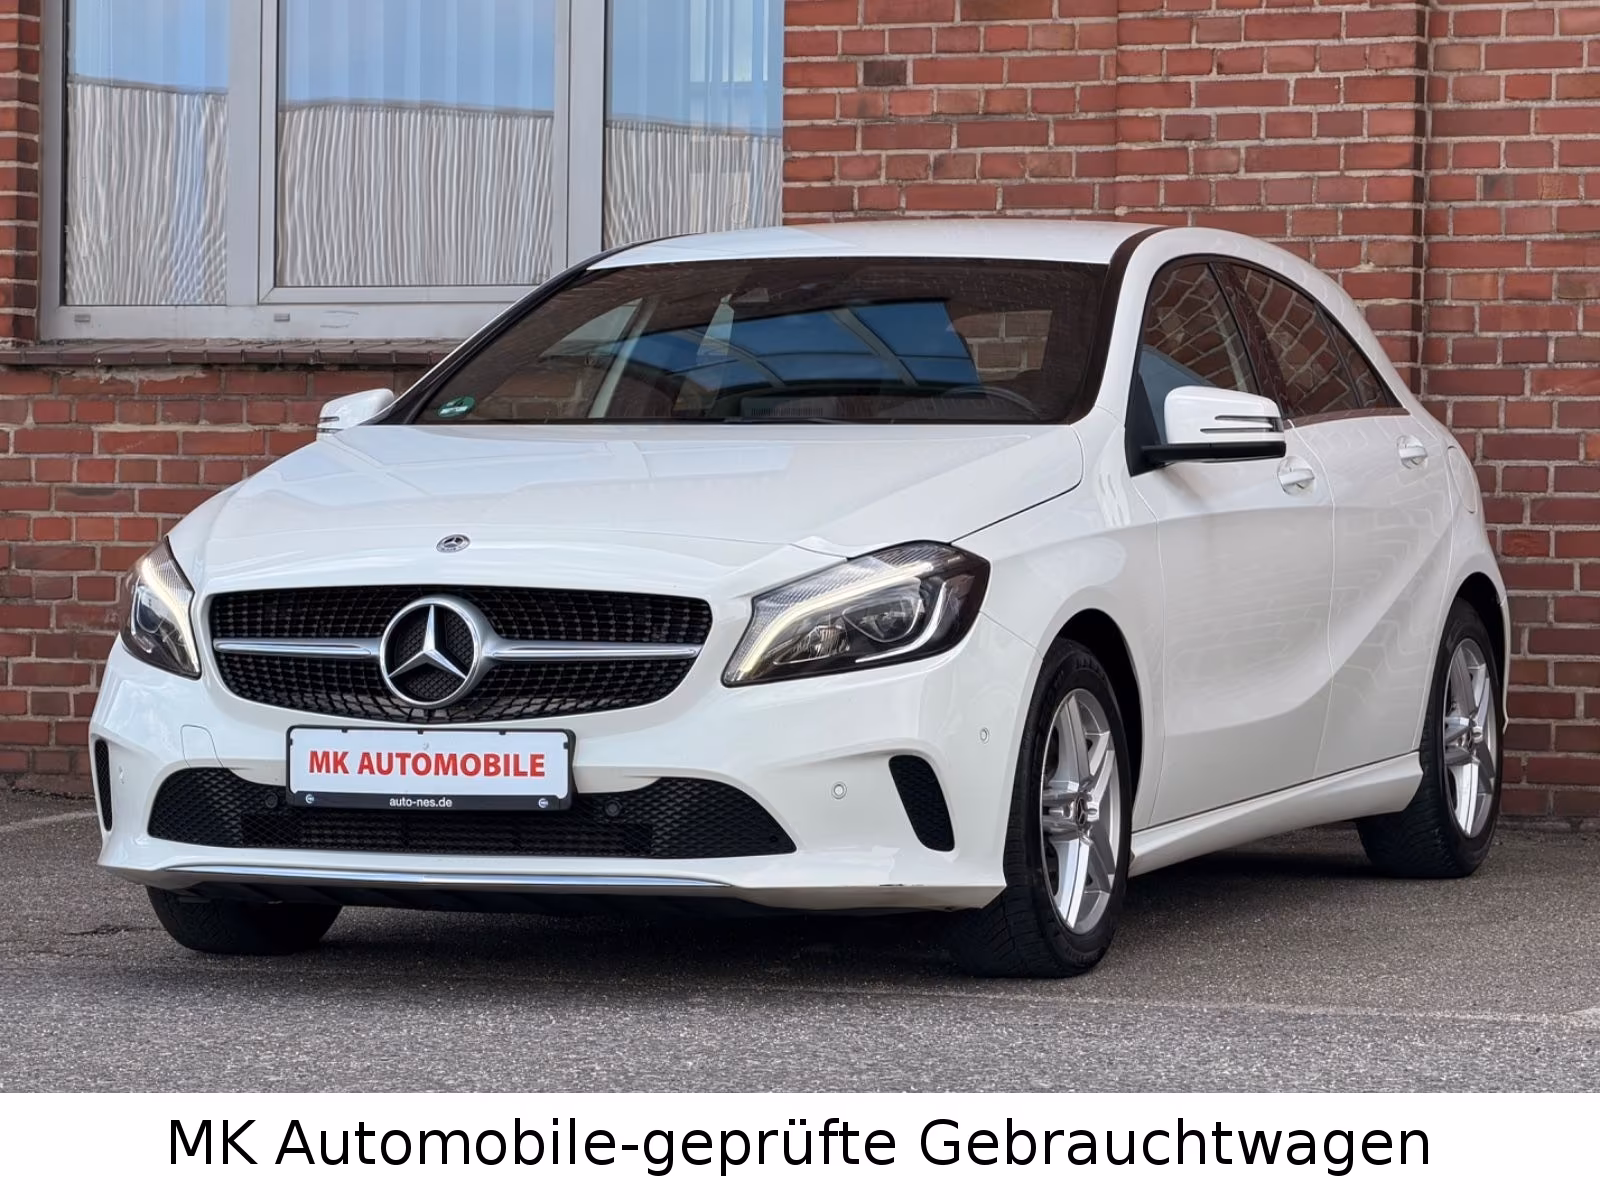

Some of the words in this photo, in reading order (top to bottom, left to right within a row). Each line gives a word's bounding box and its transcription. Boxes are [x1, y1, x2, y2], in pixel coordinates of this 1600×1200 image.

[309, 751, 349, 774] MK
[357, 752, 546, 777] AUTOMOBILE
[389, 796, 453, 808] auto-nes.de
